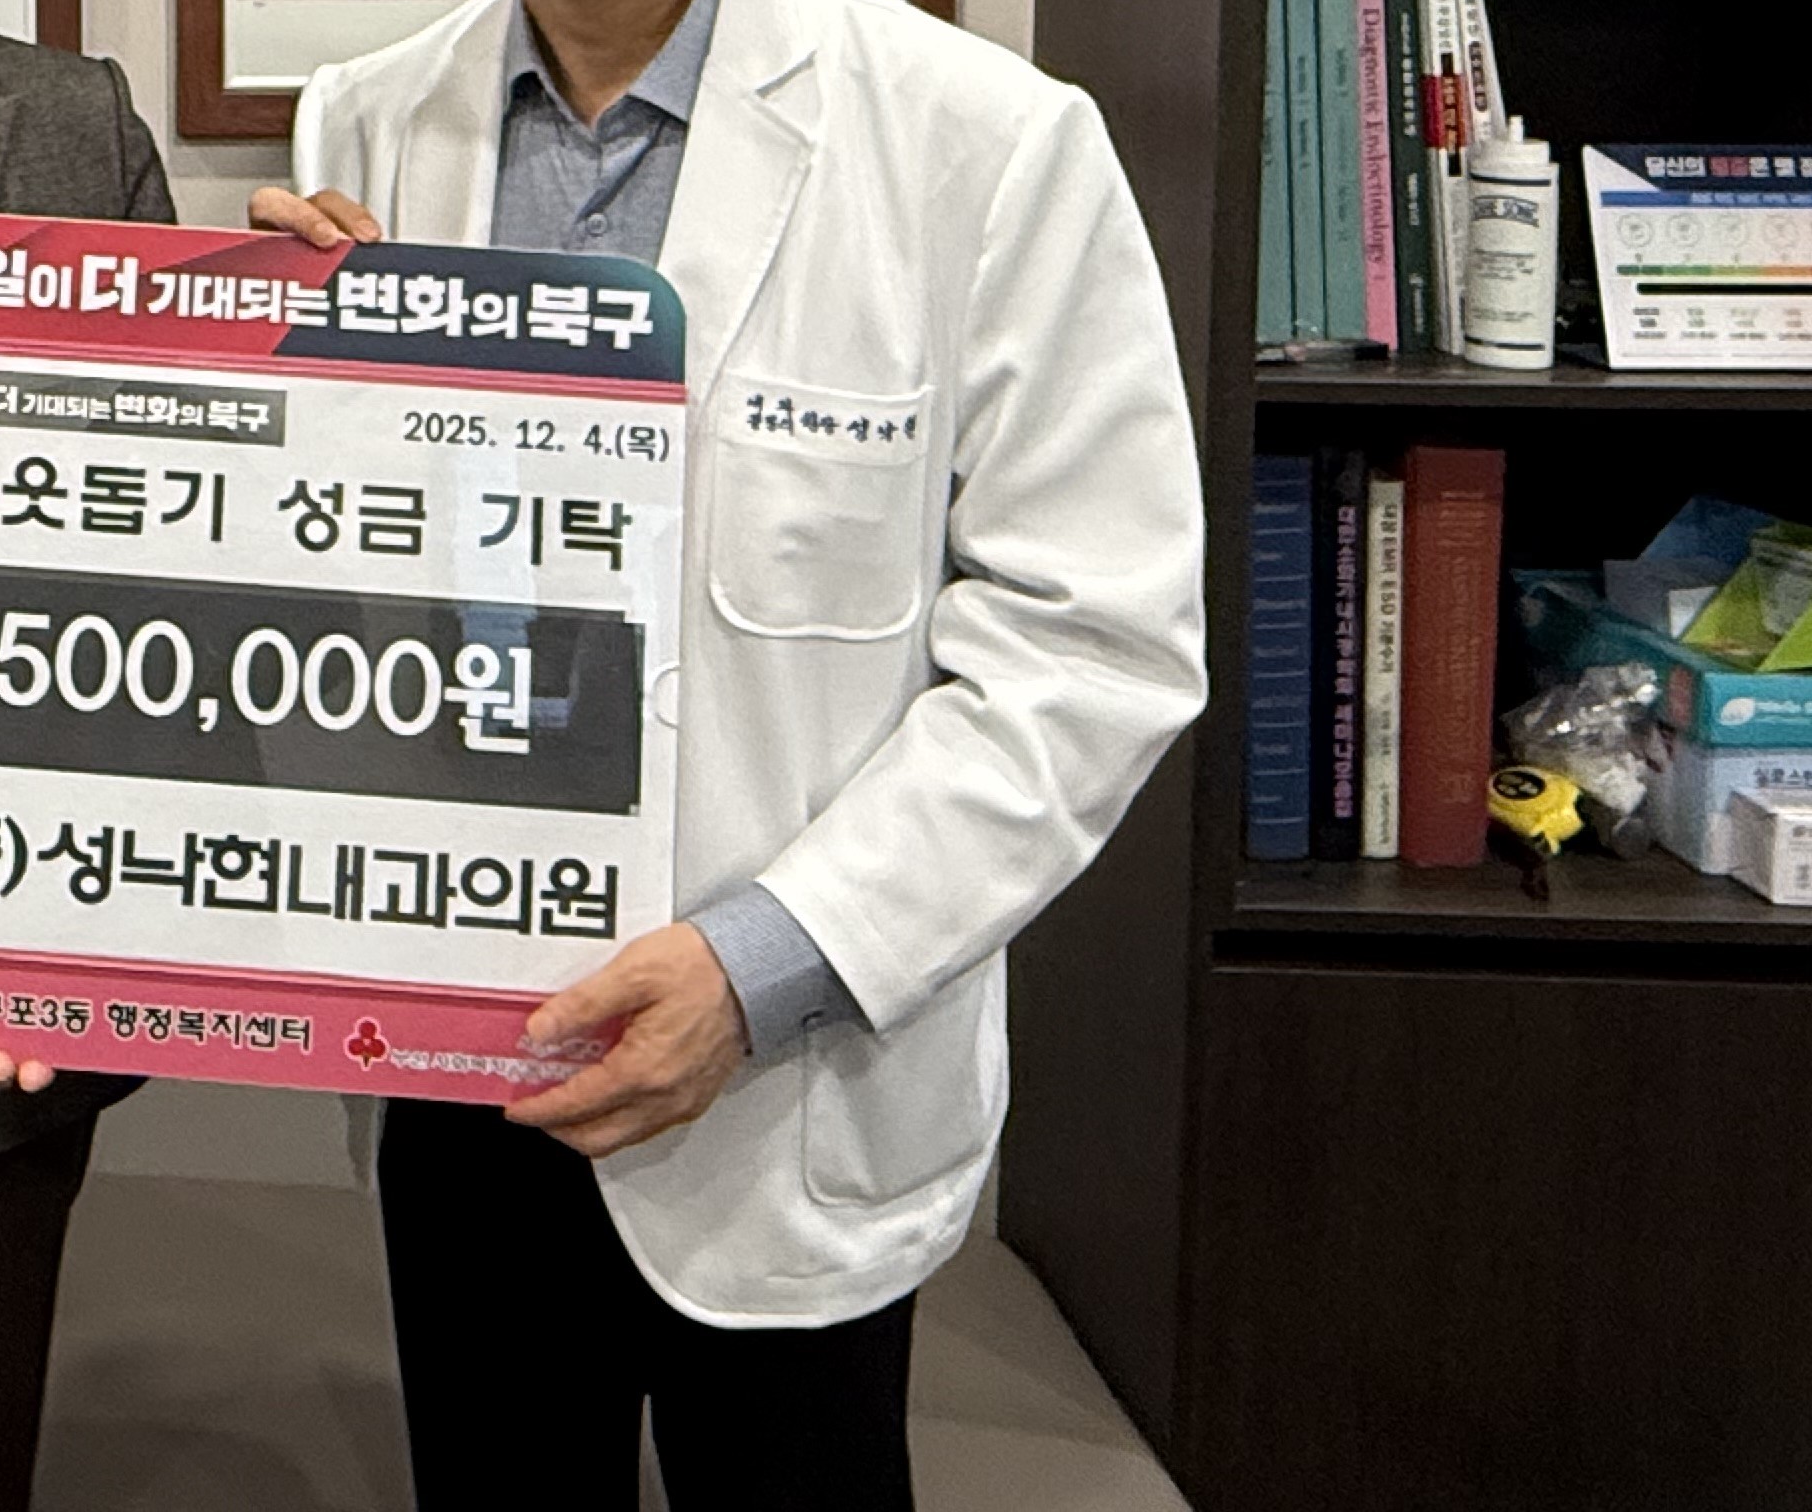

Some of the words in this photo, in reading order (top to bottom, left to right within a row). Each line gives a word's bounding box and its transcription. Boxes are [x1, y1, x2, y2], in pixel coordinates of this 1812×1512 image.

[78, 253, 141, 317] 더
[146, 272, 331, 329] 기대되는
[336, 271, 519, 340] 변화의
[526, 282, 654, 351] 북구
[21, 391, 112, 421] 기대되는
[114, 393, 204, 426] 변화의
[207, 400, 270, 432] 북구
[403, 411, 497, 447] 2025.
[514, 418, 566, 453] 12.
[583, 423, 671, 463] 4.(목)
[277, 478, 429, 557] 성금
[477, 491, 635, 572] 기탁
[1380, 580, 1397, 616] ESD
[105, 1001, 315, 1053] 행정복지센터
